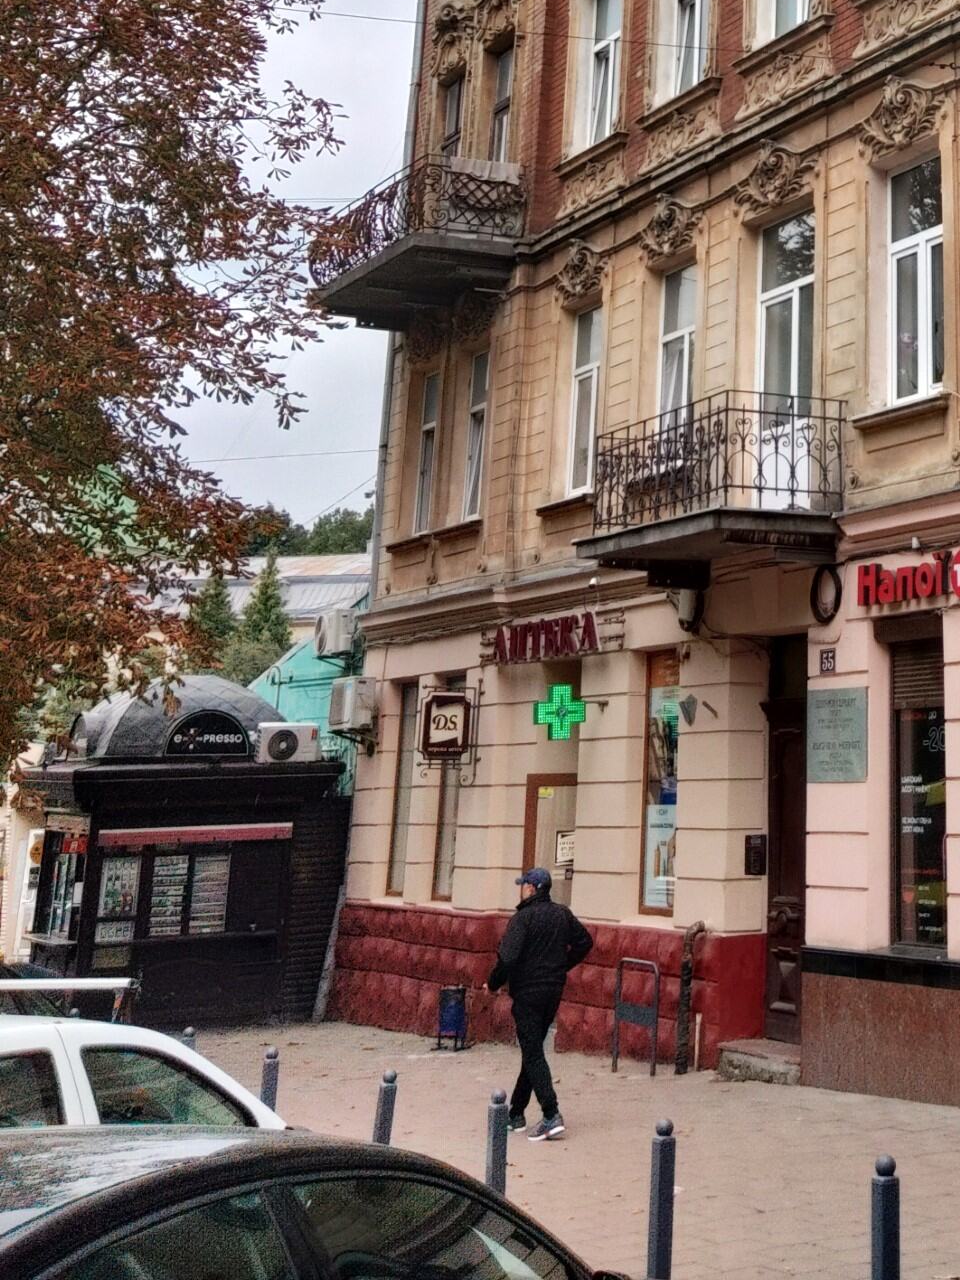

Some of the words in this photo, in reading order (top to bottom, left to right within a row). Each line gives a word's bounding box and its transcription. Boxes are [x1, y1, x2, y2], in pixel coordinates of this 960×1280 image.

[857, 551, 949, 606] Напої
[495, 612, 599, 663] АПТЕКА
[822, 652, 834, 670] 55
